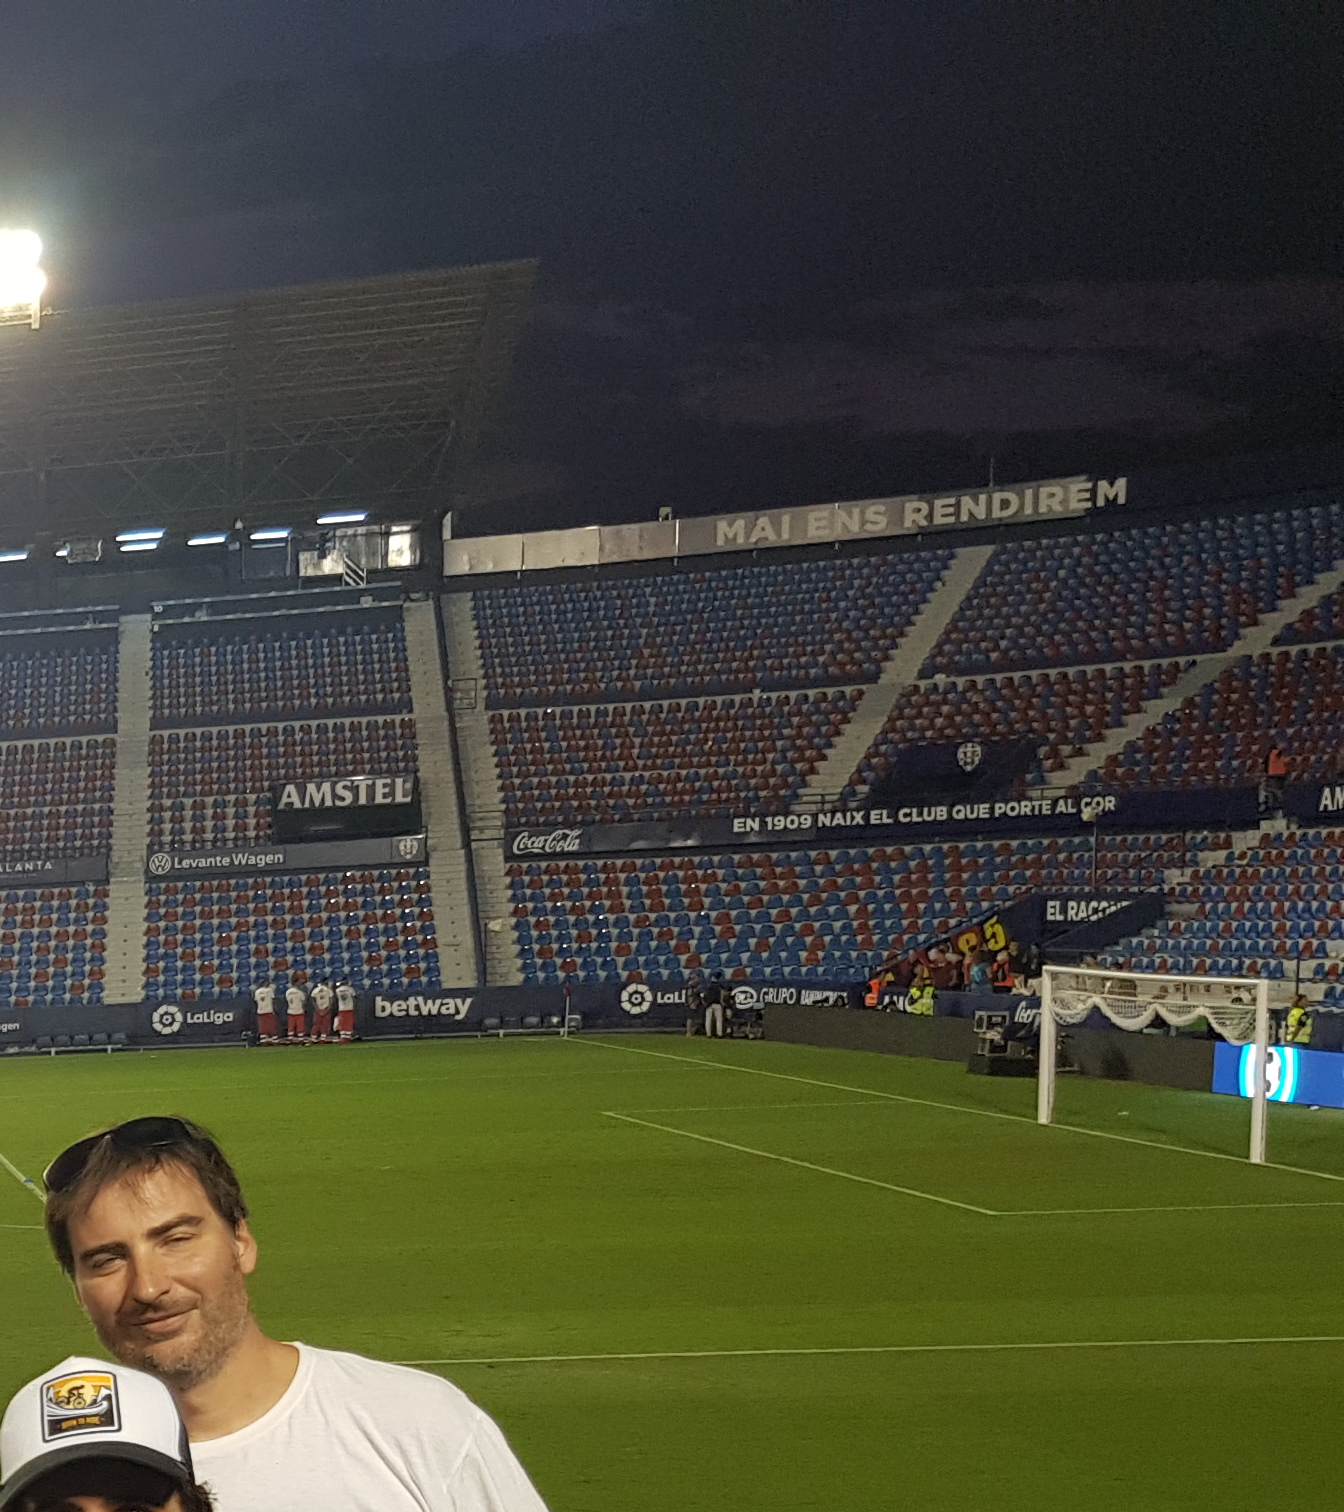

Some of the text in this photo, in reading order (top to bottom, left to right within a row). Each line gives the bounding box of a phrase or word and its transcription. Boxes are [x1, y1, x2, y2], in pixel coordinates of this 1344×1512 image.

[715, 476, 1128, 547] MAI ENS RENDIREM
[277, 777, 412, 810] AMSTEL
[733, 796, 1116, 833] EN 1909 NAIX EL CLUB QUE PORTE AL COR
[174, 851, 284, 870] Levante Wagen
[1046, 900, 1064, 921] EL
[657, 989, 687, 1004] LaLi
[760, 988, 797, 1005] GRUPO
[375, 996, 474, 1020] betway
[186, 1010, 234, 1028] LaLiga
